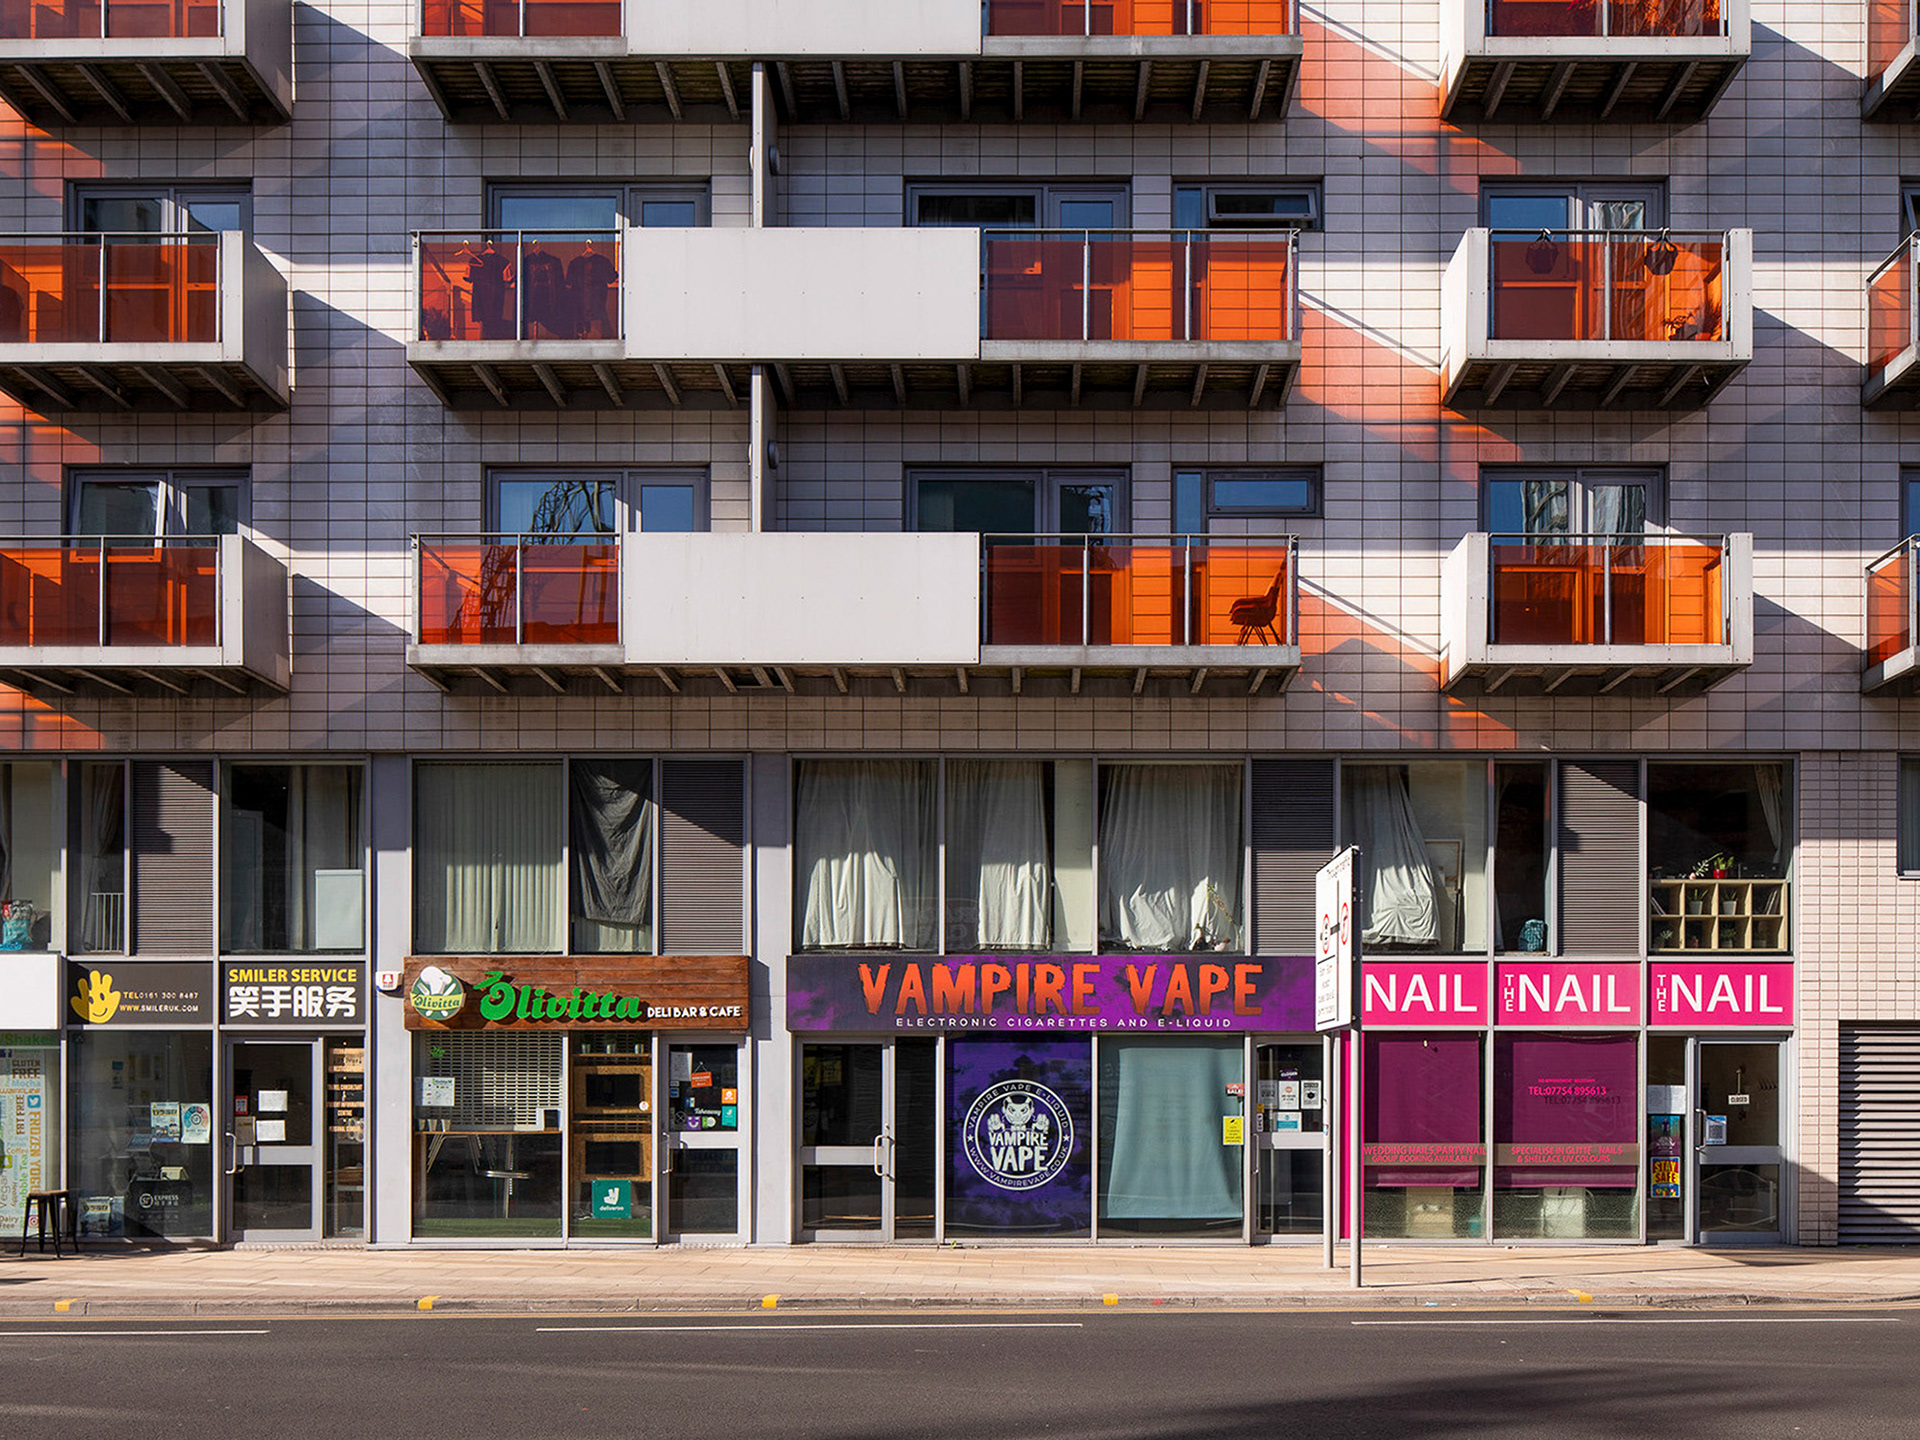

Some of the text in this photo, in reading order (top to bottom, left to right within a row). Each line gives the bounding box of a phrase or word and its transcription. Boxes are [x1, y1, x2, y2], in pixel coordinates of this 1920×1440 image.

[228, 968, 357, 983] SMILER SERVICE
[857, 962, 1100, 1015] VAMPIRE
[1125, 962, 1263, 1015] VAPE
[1365, 974, 1478, 1012] NAIL
[1504, 974, 1514, 1012] THE
[1519, 974, 1631, 1012] NAIL
[1656, 974, 1667, 1012] THE
[1671, 974, 1784, 1013] NAIL
[119, 1004, 199, 1012] WWW.SMILERUK.COM
[228, 985, 358, 1018] 笑手服务
[413, 993, 461, 1009] Olivitta
[480, 981, 642, 1021] Olivitta
[646, 1006, 741, 1018] DELI BAR & CAFE
[896, 1017, 1232, 1027] ELECTRONIC CIGARETTES AND E-LIQUID
[12, 1068, 40, 1079] FREE
[1573, 1086, 1607, 1096] 895613
[16, 1095, 25, 1116] FREE
[968, 1089, 1000, 1130] VAMPIRE
[1002, 1083, 1031, 1093] VAPE
[29, 1111, 41, 1157] FROZEN
[988, 1131, 1049, 1146] VAMPIRE
[989, 1146, 1049, 1172] VAPE
[1654, 1161, 1677, 1172] STAY
[1654, 1172, 1677, 1183] SAFE
